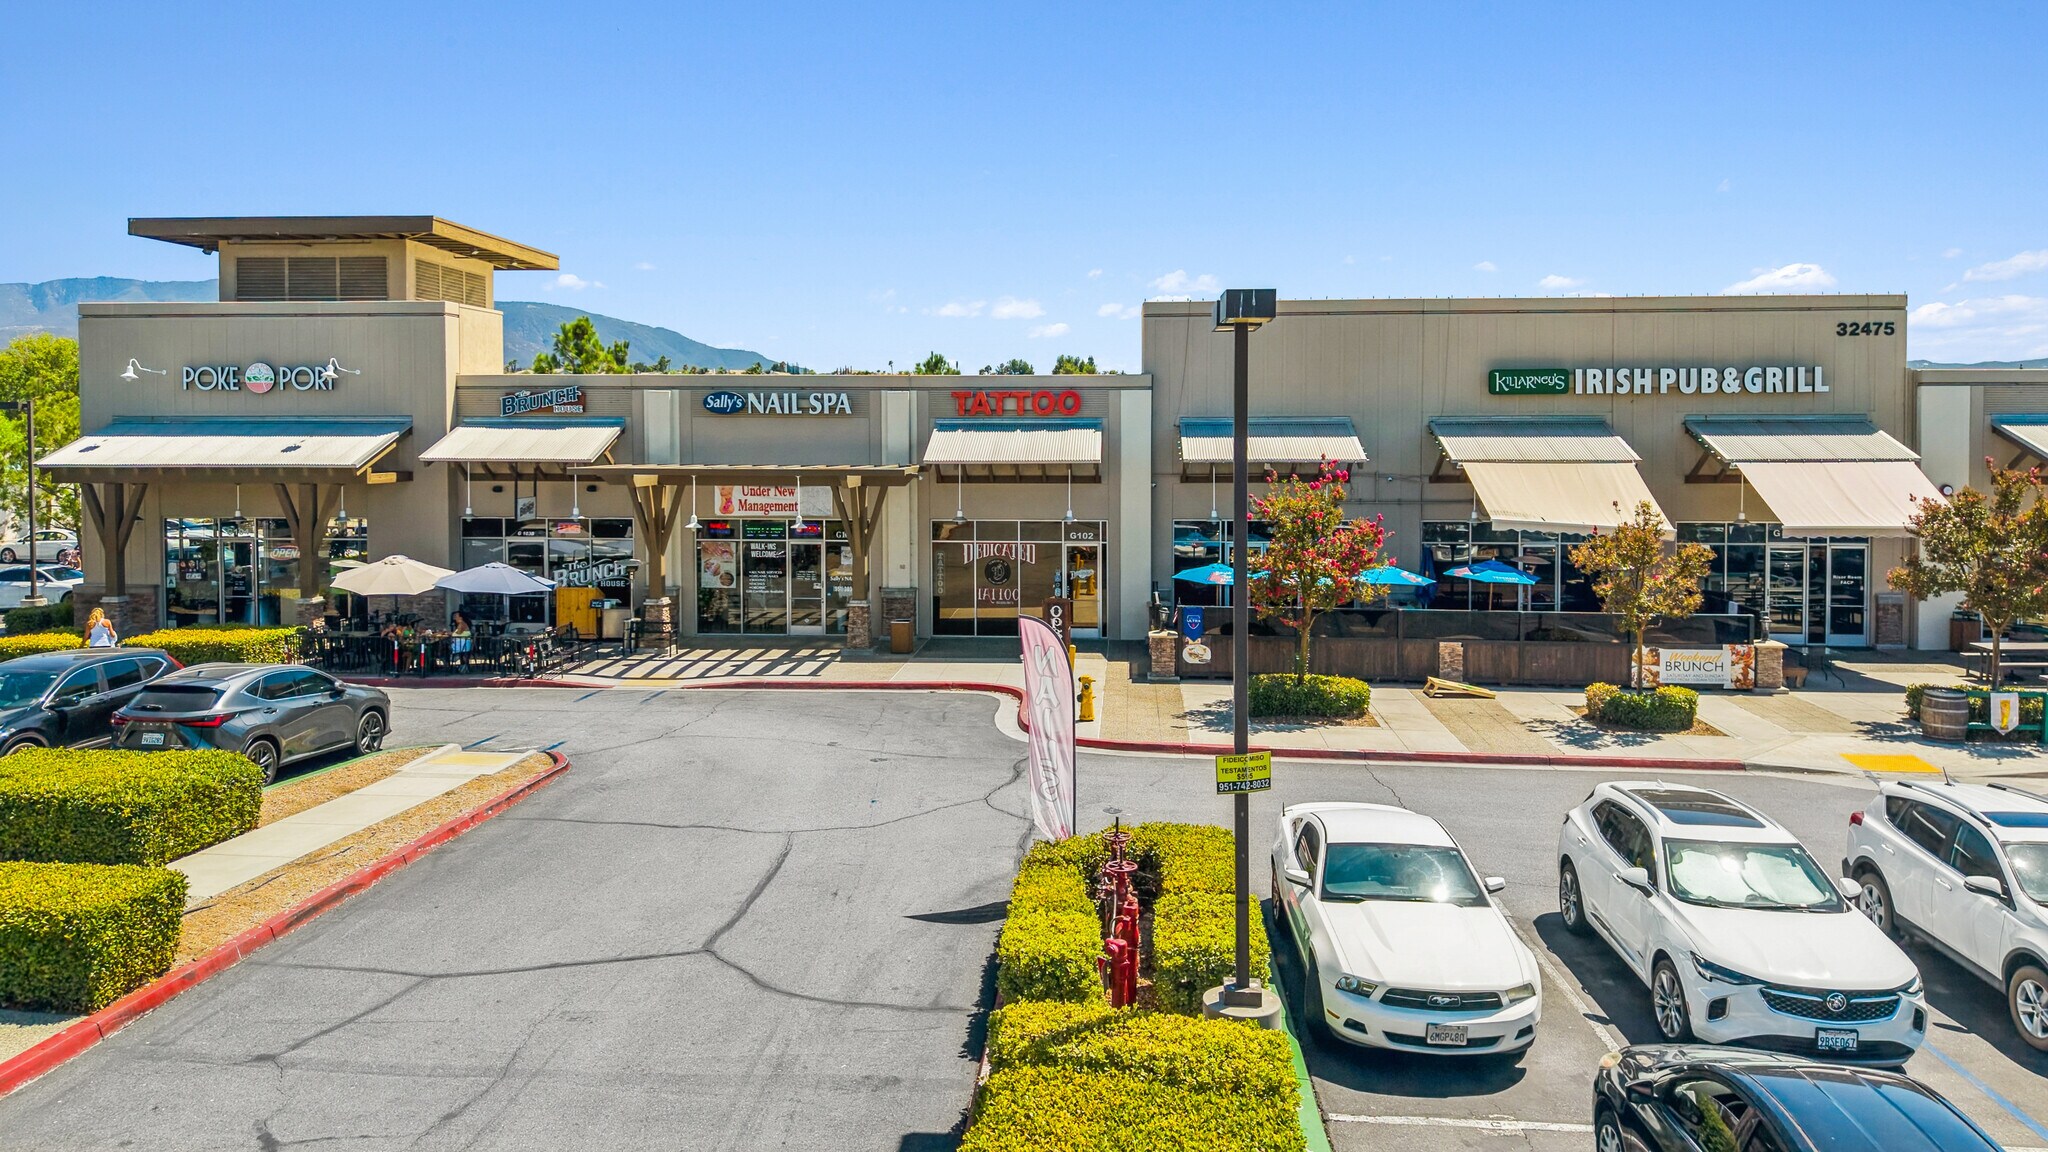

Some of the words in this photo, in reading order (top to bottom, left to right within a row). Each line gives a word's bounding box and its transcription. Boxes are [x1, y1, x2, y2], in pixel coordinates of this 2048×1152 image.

[1836, 321, 1895, 337] 32475
[182, 366, 240, 391] POKE
[1574, 368, 1652, 395] IRISH
[500, 385, 582, 417] BRUNCH
[706, 394, 743, 412] Sally's
[747, 392, 803, 414] NAIL
[809, 392, 852, 414] SPA
[950, 390, 1082, 416] TATTOO
[553, 405, 583, 413] HOUSE
[742, 485, 771, 497] Under
[774, 485, 795, 497] New
[738, 498, 798, 515] Management
[1773, 529, 1781, 537] G
[271, 548, 298, 557] OPEN
[751, 550, 776, 558] WELCOME
[962, 543, 1036, 565] DEDICATED
[553, 562, 628, 587] BRUNCH
[936, 552, 944, 594] TATTOO
[1668, 651, 1723, 662] Weekend
[1665, 661, 1724, 672] BRUNCH
[1220, 765, 1267, 774] TESTAMENTOS
[1219, 779, 1270, 791] 951-742-8032
[1429, 1032, 1465, 1043] 6MGP480
[1819, 1036, 1856, 1047] 9BSE067
